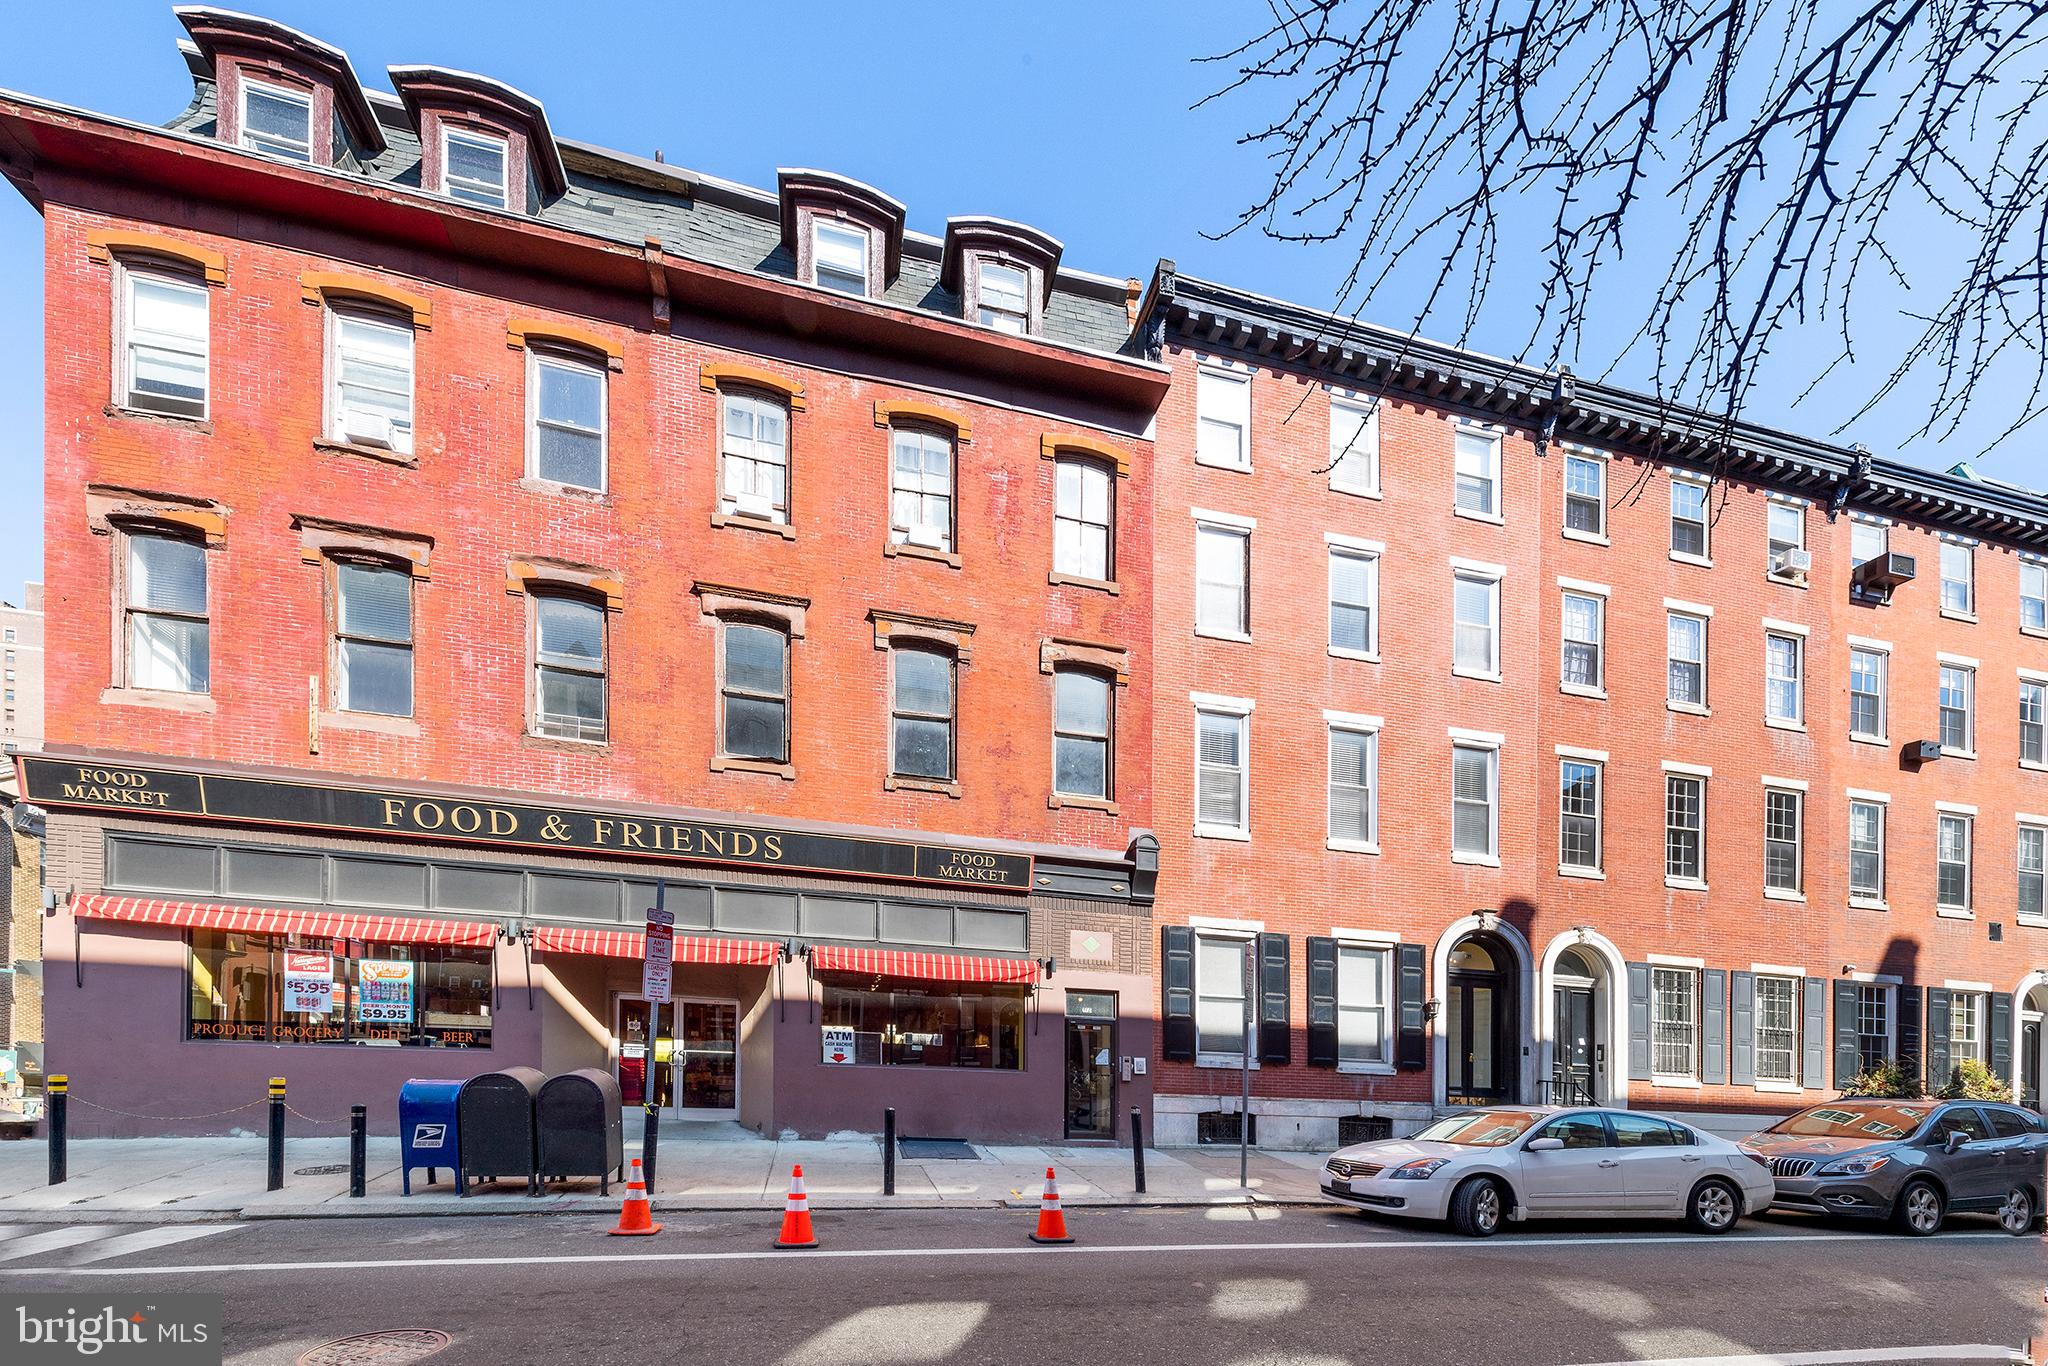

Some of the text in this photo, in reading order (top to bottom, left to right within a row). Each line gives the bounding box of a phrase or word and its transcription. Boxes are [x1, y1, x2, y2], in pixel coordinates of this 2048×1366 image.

[78, 768, 148, 788] FOOD
[62, 783, 168, 806] MARKET
[380, 798, 783, 860] FOOD & FRIENDS
[951, 853, 996, 867] FOOD
[939, 865, 1009, 882] MARKET
[647, 930, 671, 940] STOPPING
[652, 946, 666, 954] TIME
[287, 981, 330, 994] $5.95
[362, 1008, 407, 1019] $9.95
[193, 1023, 266, 1036] PRODUCE
[272, 1026, 343, 1038] GROCERY
[443, 1032, 474, 1042] BEER
[825, 1031, 852, 1040] ATM
